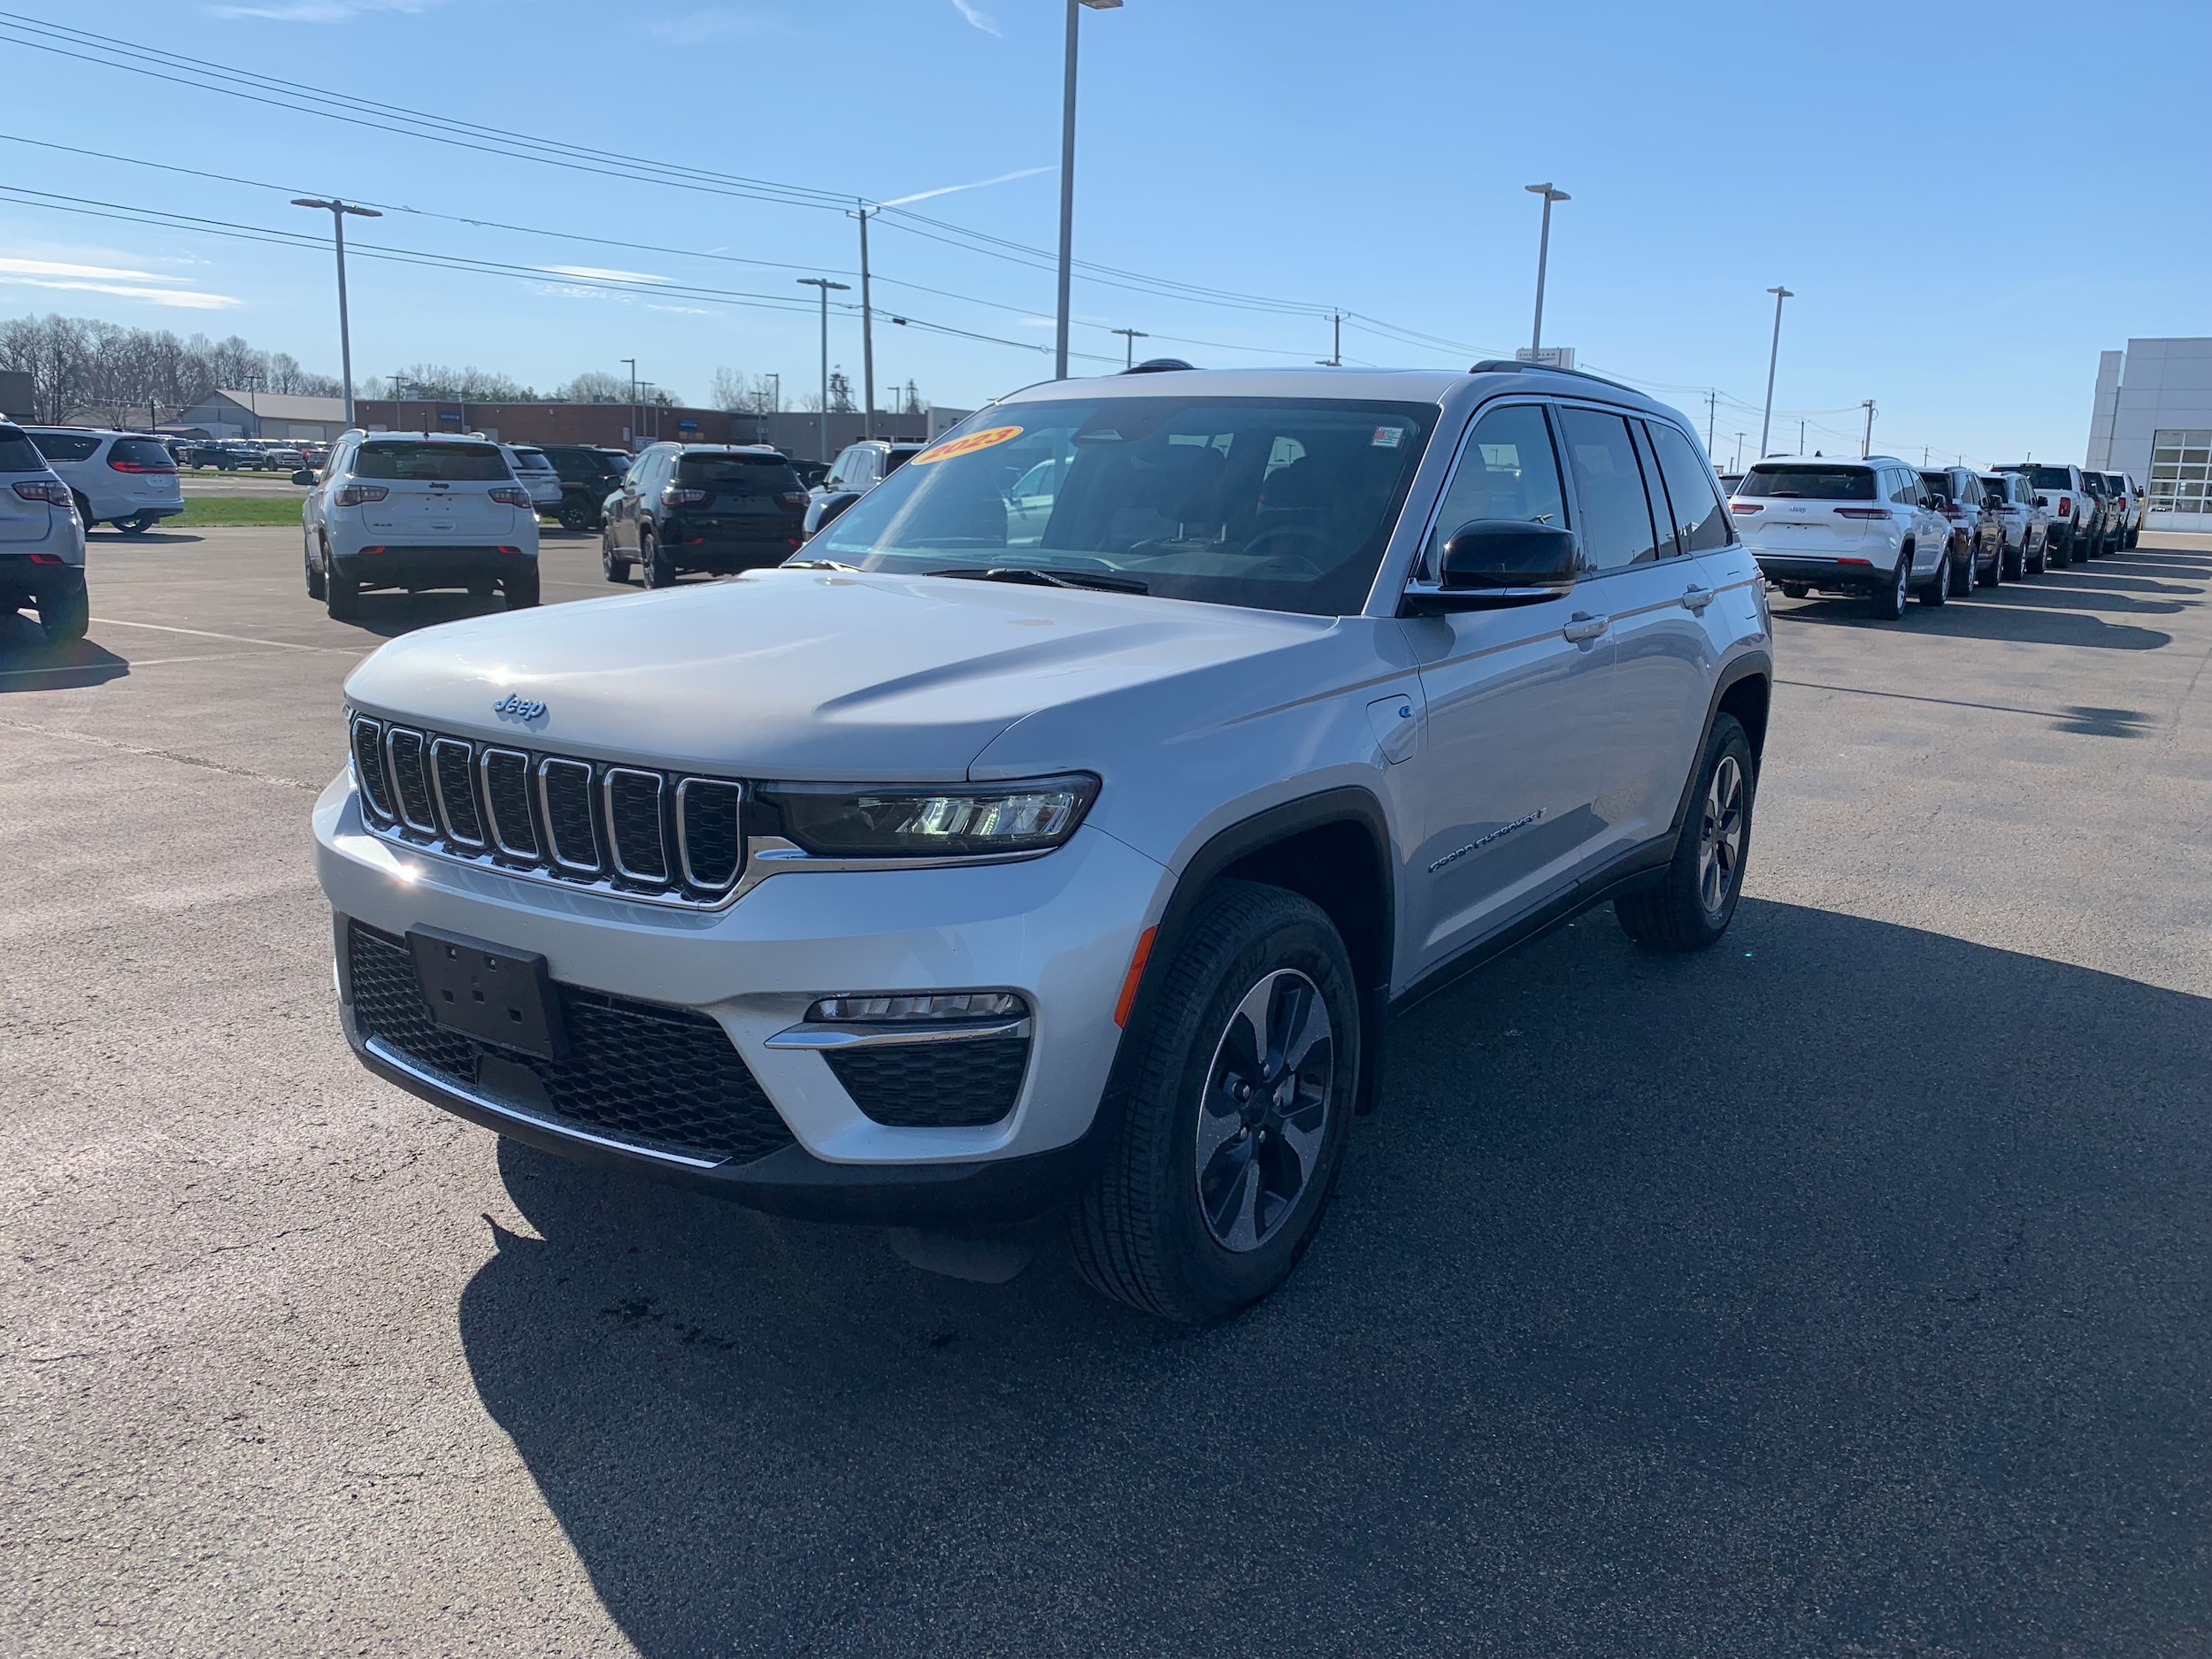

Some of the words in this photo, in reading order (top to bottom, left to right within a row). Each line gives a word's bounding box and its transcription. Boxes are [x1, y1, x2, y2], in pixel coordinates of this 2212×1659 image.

[920, 428, 1015, 461] 2023
[428, 481, 449, 490] Jeep
[492, 692, 546, 721] Jeep
